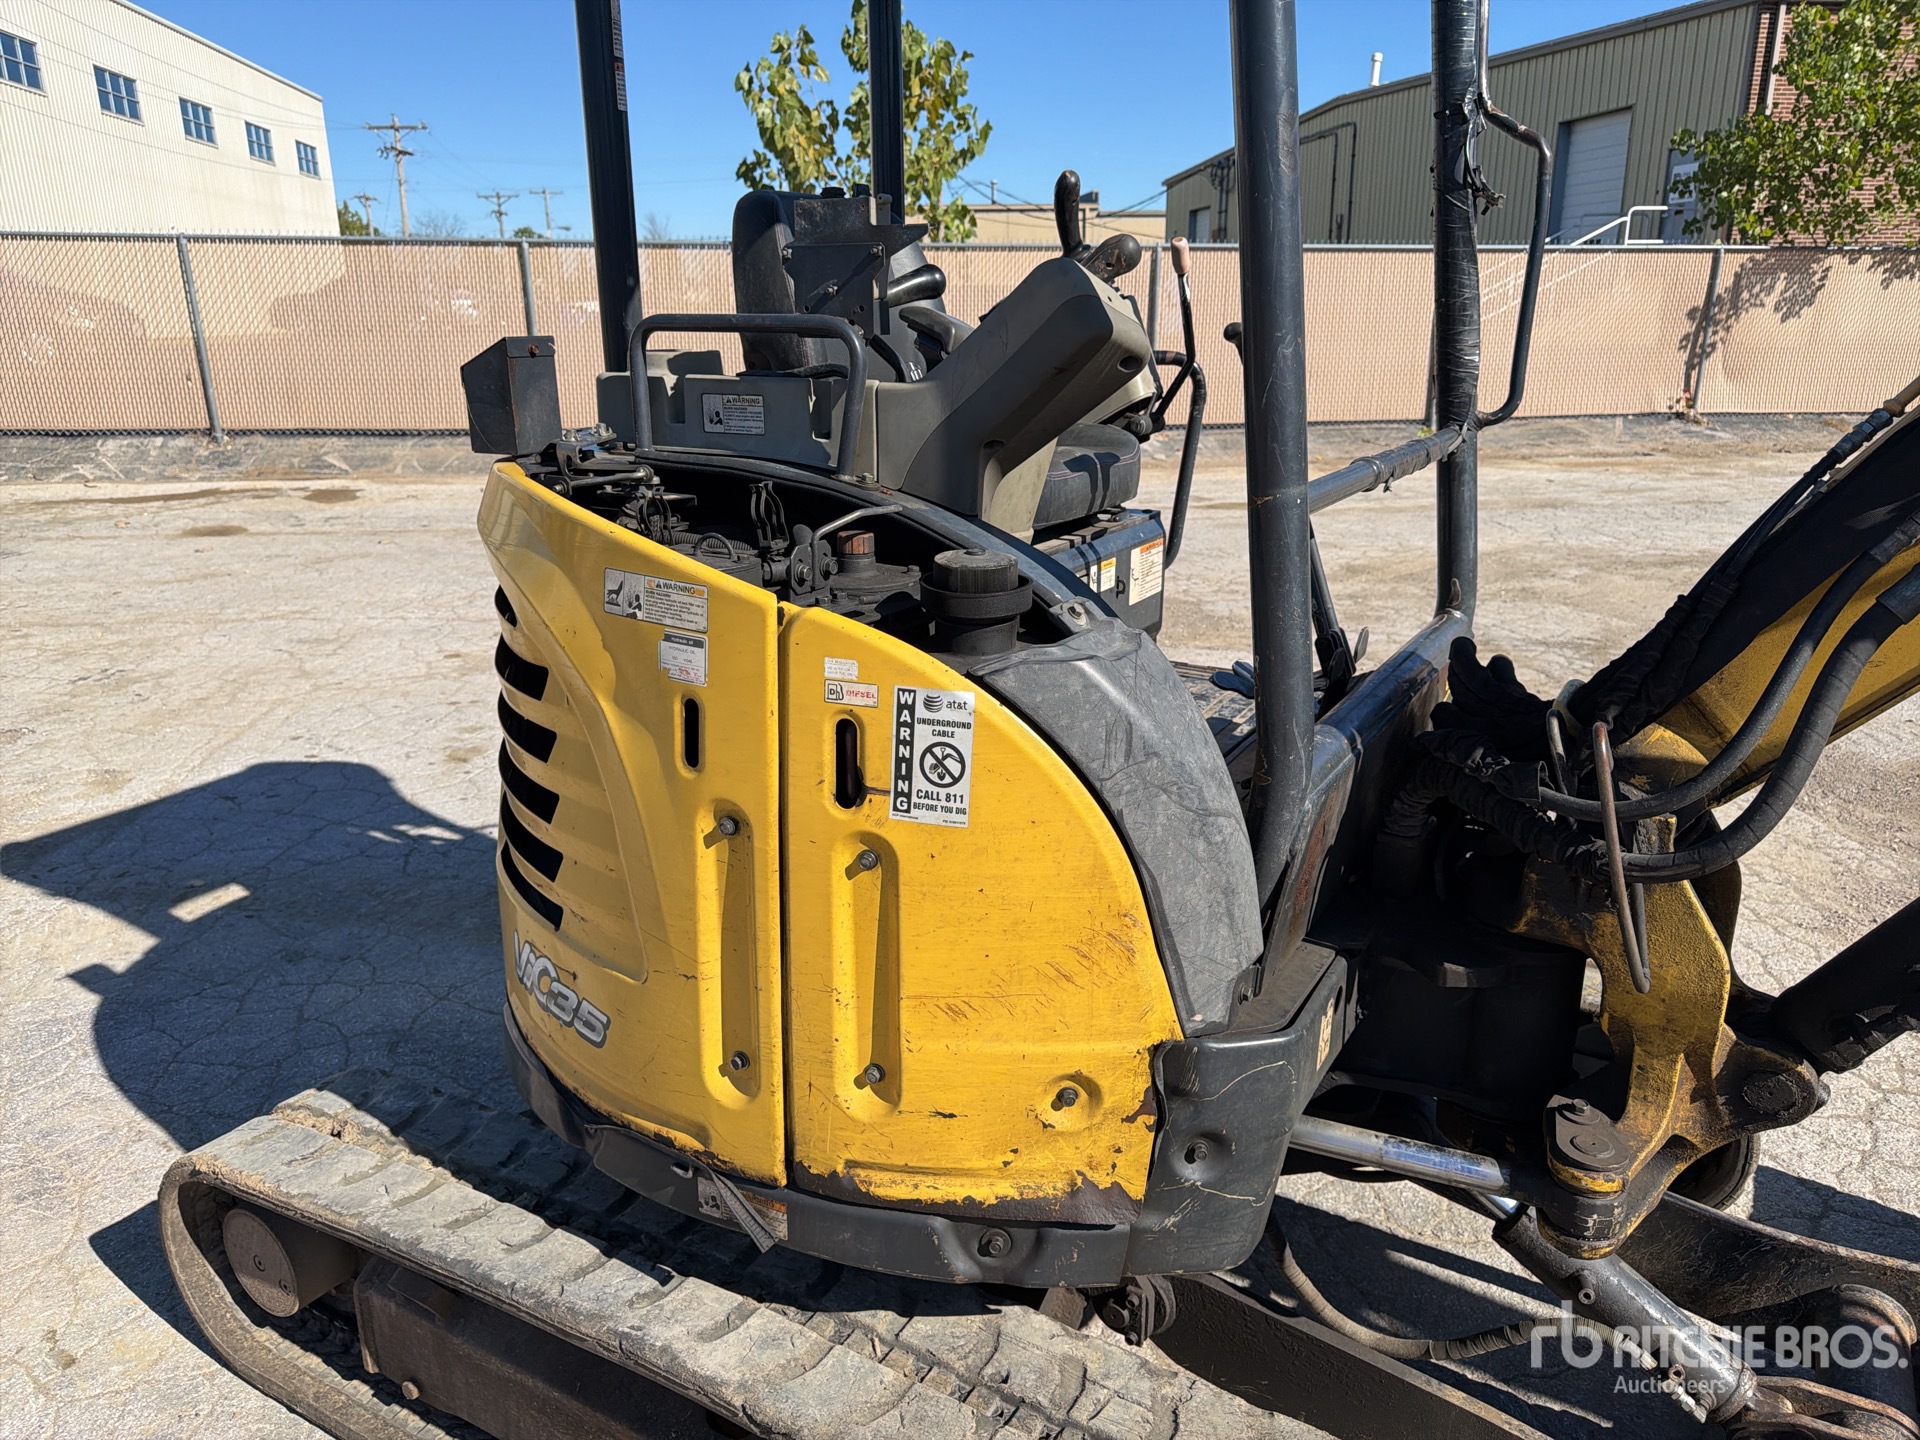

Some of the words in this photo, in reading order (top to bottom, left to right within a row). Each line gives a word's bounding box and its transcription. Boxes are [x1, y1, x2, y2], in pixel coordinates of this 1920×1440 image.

[663, 582, 695, 594] WARNING
[946, 700, 968, 710] at&t
[917, 717, 971, 729] UNDERGROUND
[932, 729, 955, 738] CABLE
[896, 691, 914, 810] WARNING
[916, 789, 941, 801] CALL
[945, 793, 964, 804] 811
[913, 802, 938, 812] BEFORE
[940, 805, 953, 815] YOU
[955, 806, 967, 815] DIG
